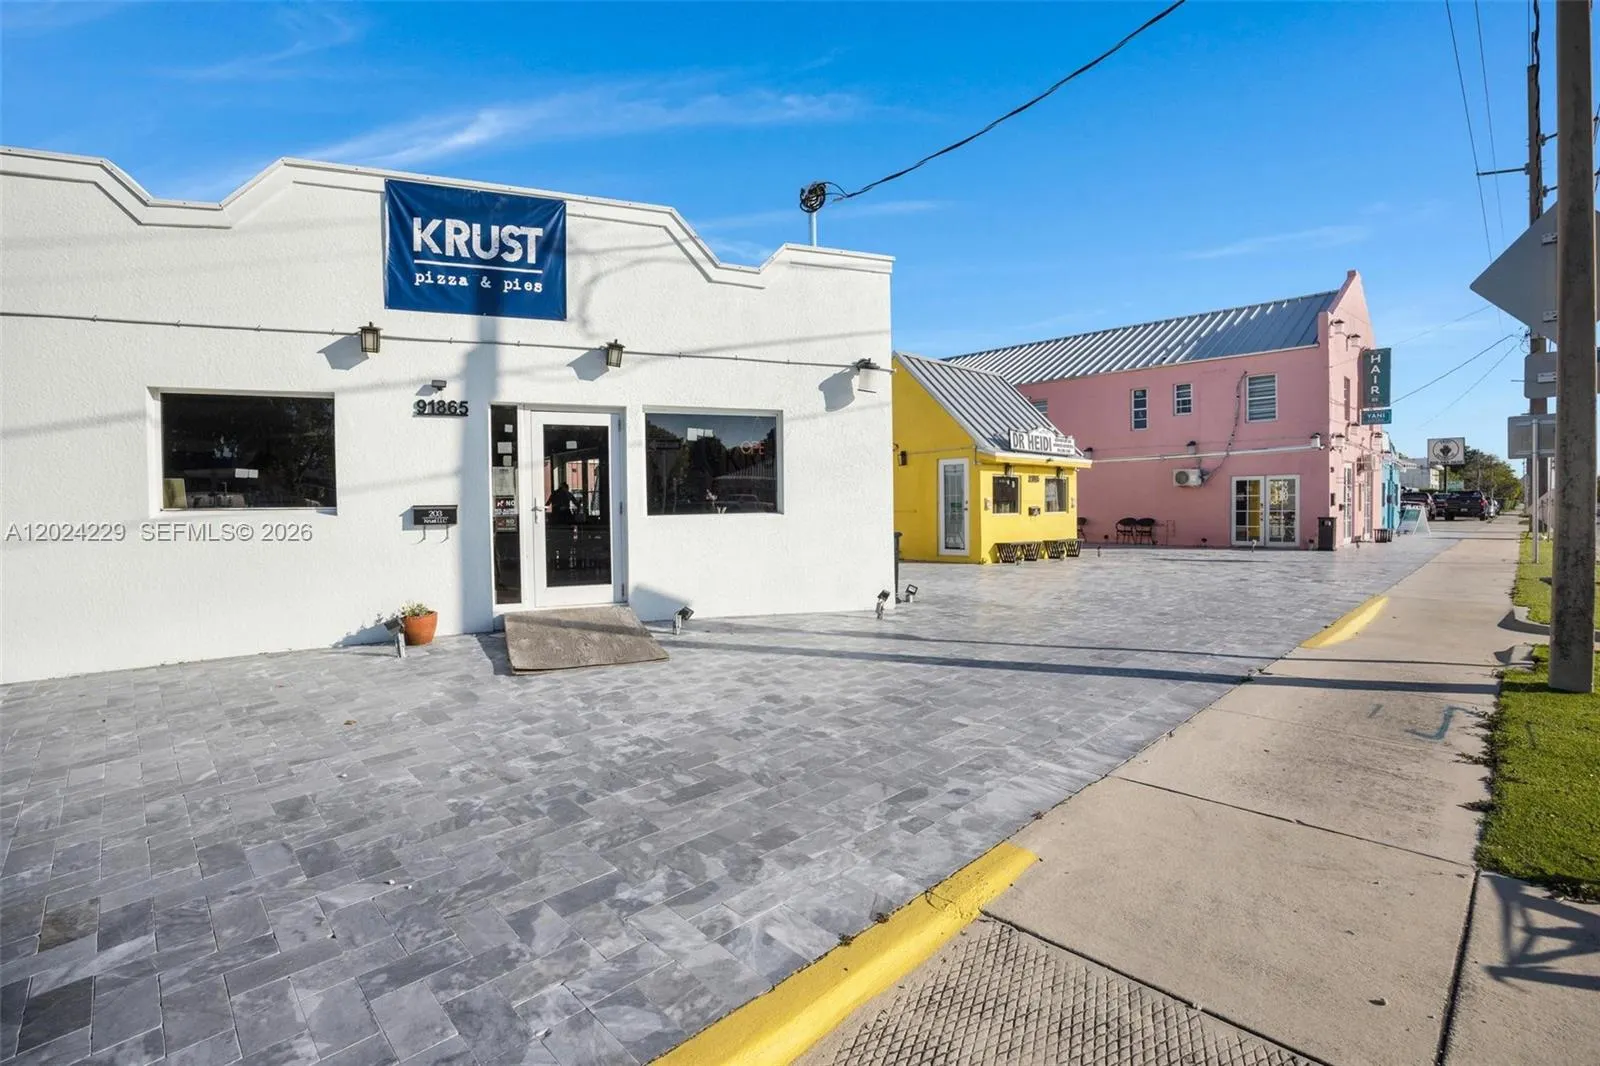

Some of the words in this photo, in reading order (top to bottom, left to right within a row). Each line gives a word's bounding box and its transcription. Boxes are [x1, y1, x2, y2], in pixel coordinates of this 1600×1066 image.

[413, 217, 543, 264] KRUST
[414, 271, 469, 286] pizza
[480, 275, 492, 289] &
[503, 278, 543, 293] pies
[1370, 354, 1380, 394] HAIR
[416, 399, 469, 416] 91865
[1012, 433, 1024, 449] DR
[1028, 435, 1052, 452] HEIDI
